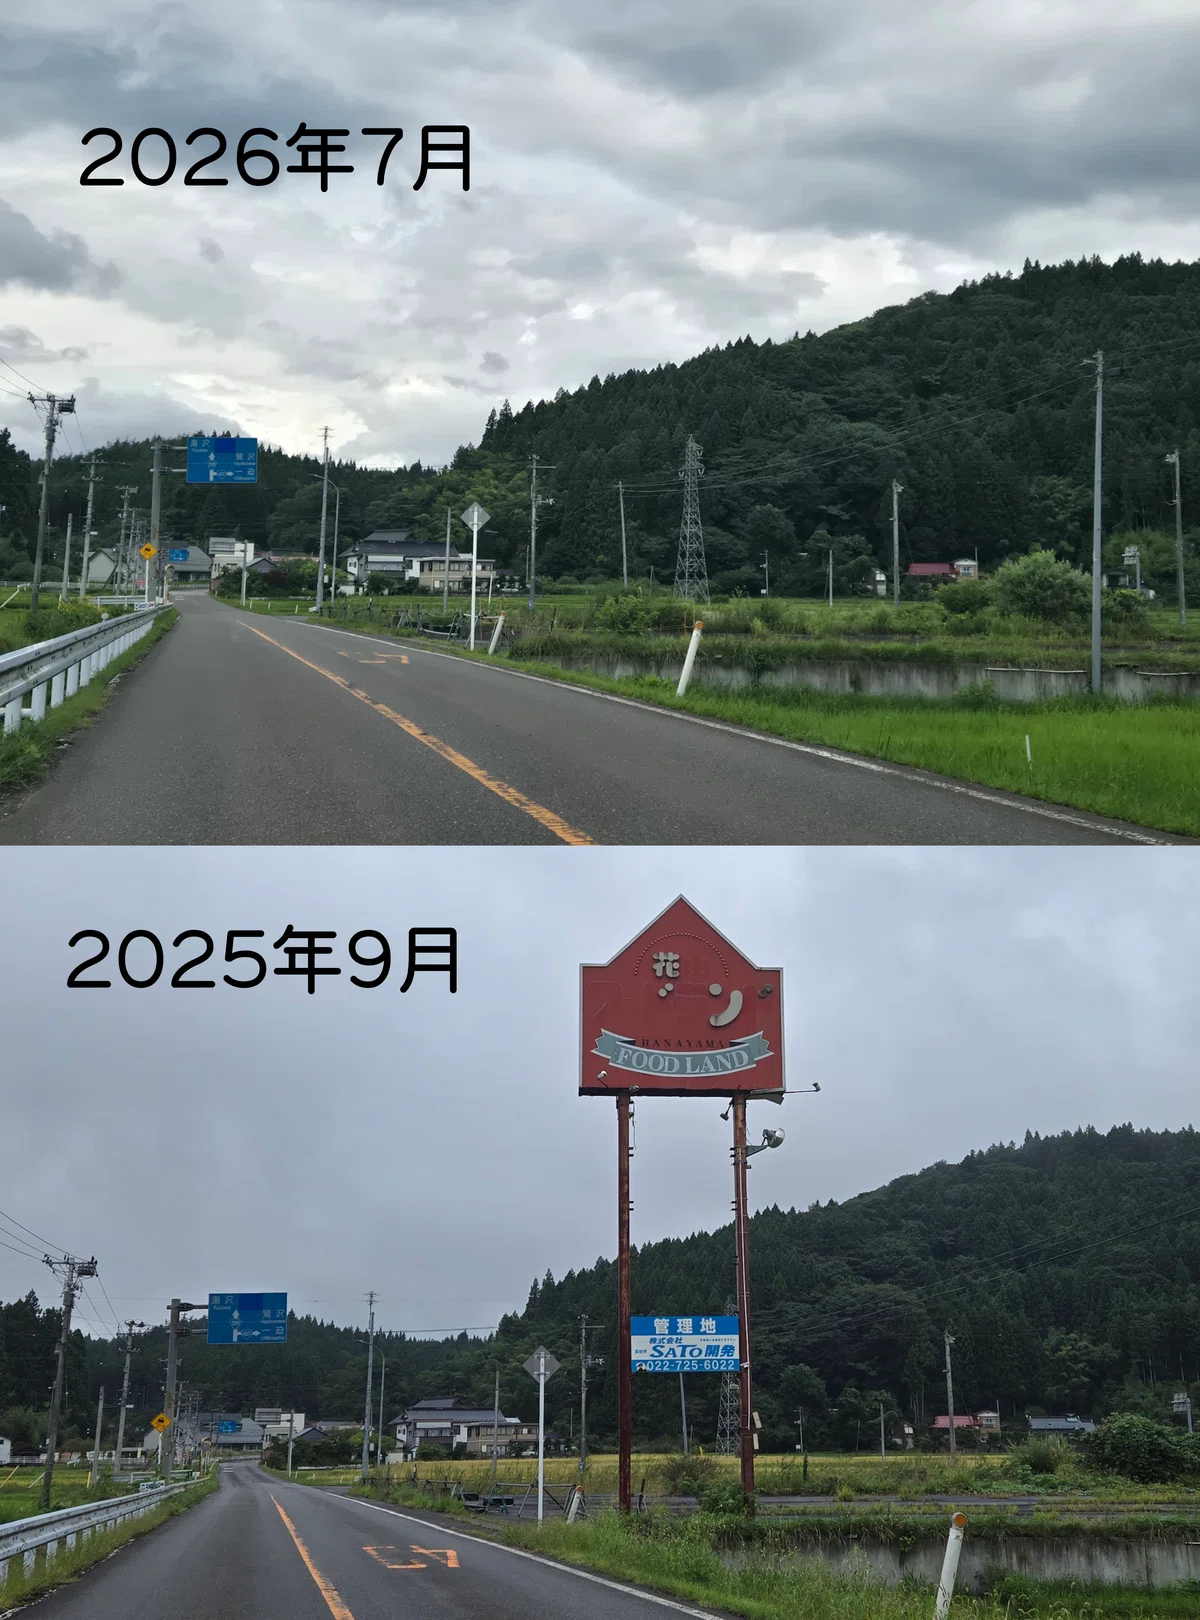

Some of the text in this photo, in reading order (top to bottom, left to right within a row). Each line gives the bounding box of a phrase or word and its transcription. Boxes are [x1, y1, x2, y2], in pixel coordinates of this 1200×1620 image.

[641, 1038, 724, 1049] HANAYAMA
[616, 1047, 749, 1074] FOOD LAND
[654, 1317, 717, 1335] 管理地
[649, 1336, 683, 1345] 株式会社
[646, 1360, 735, 1371] 022-725-6022
